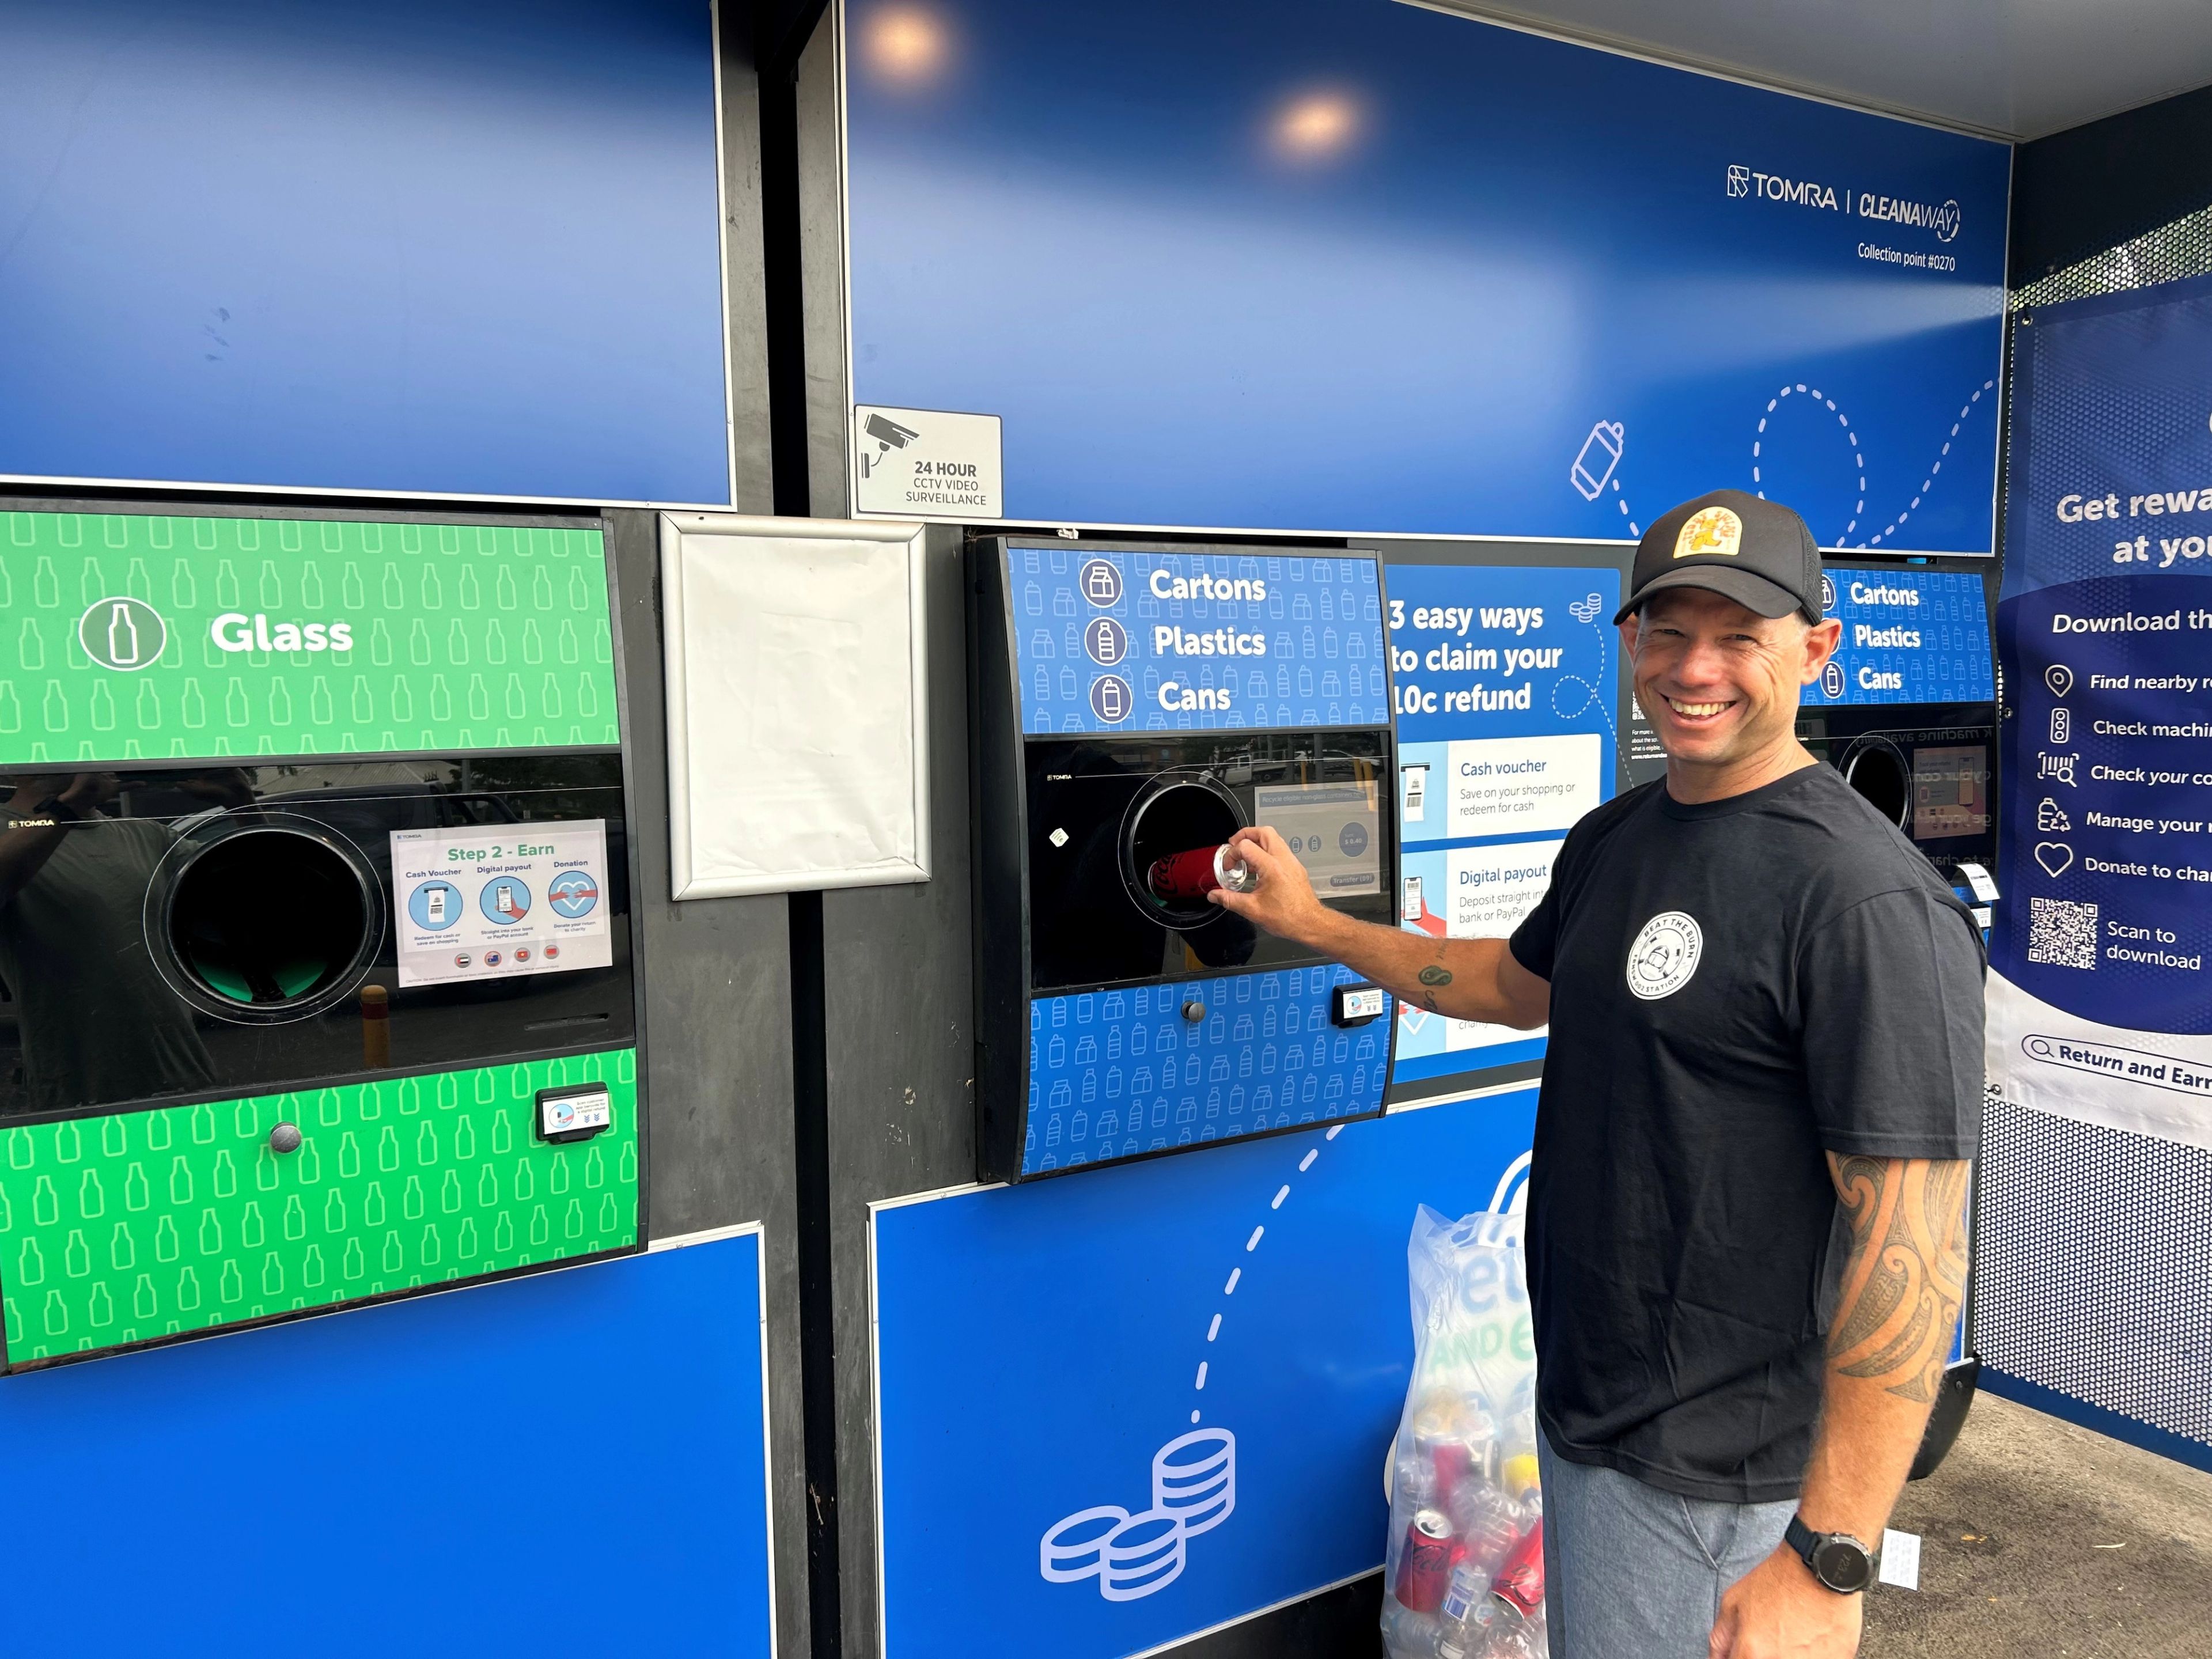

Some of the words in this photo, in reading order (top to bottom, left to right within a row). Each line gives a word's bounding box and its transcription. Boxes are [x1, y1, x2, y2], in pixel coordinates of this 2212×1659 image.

[1752, 172, 1838, 210] TOMRA
[1859, 192, 1956, 232] CLEANAWAY
[1858, 242, 1902, 264] Collection
[1903, 252, 1926, 267] point
[1927, 254, 1956, 271] #0270
[915, 461, 933, 475] 24
[936, 462, 977, 477] HOUR
[914, 478, 942, 489] CCTV
[945, 479, 979, 491] VIDEO
[906, 491, 987, 505] SURVEILLANCE
[2056, 493, 2120, 523] Get
[2112, 535, 2150, 563] at
[2158, 536, 2212, 568] yo
[1149, 569, 1267, 602] Cartons
[1850, 581, 1919, 606] Cartons
[1389, 600, 1406, 630] 3
[1412, 607, 1473, 637] easy
[1479, 606, 1543, 636] ways
[2052, 609, 2180, 633] Download
[210, 612, 354, 653] Glass
[1155, 626, 1267, 656] Plastics
[1855, 624, 1921, 648] Plastics
[1391, 645, 1419, 672] to
[1425, 643, 1497, 672] claim
[1503, 647, 1563, 677] your
[1858, 666, 1902, 690] Cans
[2090, 675, 2130, 689] Find
[2134, 675, 2198, 693] nearby
[1157, 681, 1231, 711] Cans
[1394, 684, 1437, 715] 10c
[1444, 682, 1531, 713] refund
[2093, 720, 2147, 736] Check
[2152, 722, 2212, 738] machi
[1460, 762, 1492, 777] Cash
[1495, 759, 1547, 774] voucher
[2090, 765, 2145, 782] Check
[2147, 770, 2189, 786] your
[1460, 788, 1482, 800] Save
[1484, 789, 1497, 798] on
[1499, 786, 1520, 800] your
[1522, 784, 1563, 797] shopping
[1565, 783, 1575, 793] or
[1460, 803, 1496, 816] redeem
[1498, 802, 1512, 813] for
[1513, 801, 1535, 812] cash
[19, 819, 55, 828] TOMRA
[2086, 811, 2154, 833] Manage
[2158, 820, 2203, 835] your
[448, 848, 487, 862] Step
[491, 846, 502, 858] 2
[517, 844, 555, 857] Earn
[554, 860, 588, 868] Donation
[406, 870, 426, 878] Cash
[428, 869, 462, 877] Voucher
[477, 865, 502, 874] Digital
[505, 863, 532, 873] payout
[1460, 868, 1501, 887] Digital
[1504, 865, 1547, 883] payout
[2084, 857, 2147, 876] Donate
[2152, 864, 2172, 878] to
[2176, 866, 2212, 882] cha
[1459, 894, 1495, 908] Deposit
[1497, 890, 1531, 904] straight
[1533, 889, 1546, 900] int
[1459, 911, 1482, 924] bank
[1484, 912, 1494, 921] or
[1497, 906, 1526, 921] PayPal
[1644, 918, 1668, 937] BEAT
[1671, 918, 1688, 931] THE
[1685, 930, 1695, 959] BURN
[2107, 921, 2150, 941] Scan
[2156, 928, 2176, 944] to
[2106, 945, 2202, 971] download
[2059, 1044, 2123, 1071] Return
[2127, 1060, 2166, 1080] and
